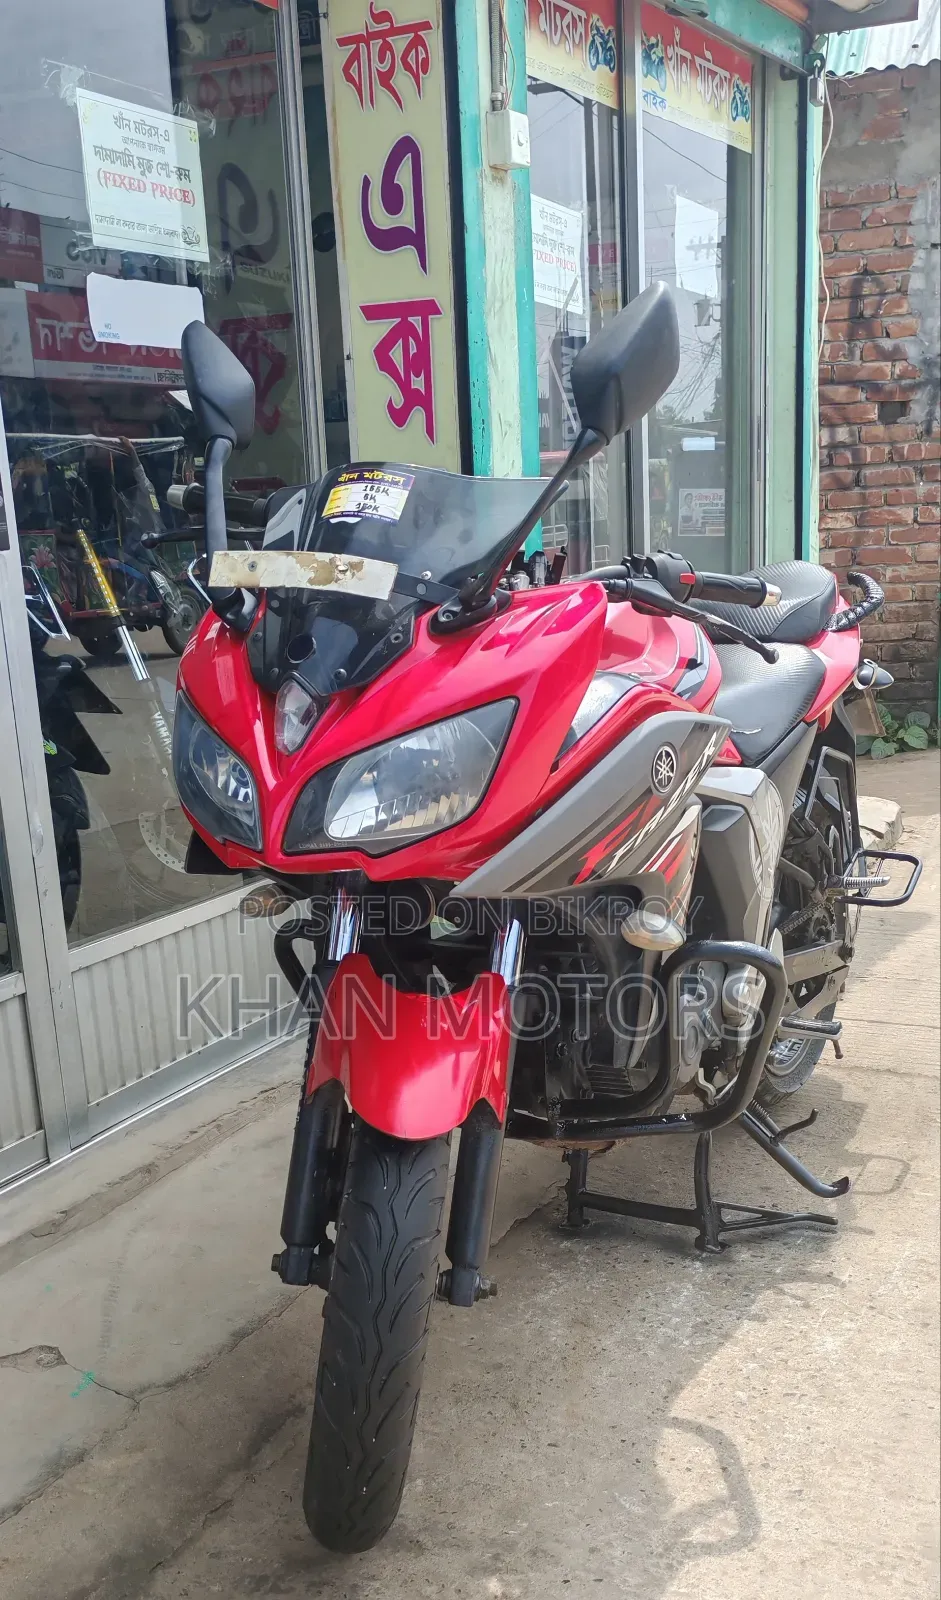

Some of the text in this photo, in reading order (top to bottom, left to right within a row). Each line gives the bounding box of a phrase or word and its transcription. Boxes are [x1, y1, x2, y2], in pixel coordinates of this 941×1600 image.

[335, 1, 434, 113] বাইক
[642, 88, 667, 112] বাইক
[93, 144, 136, 170] দামাদামি
[97, 167, 196, 207] (FIXED PRICE)
